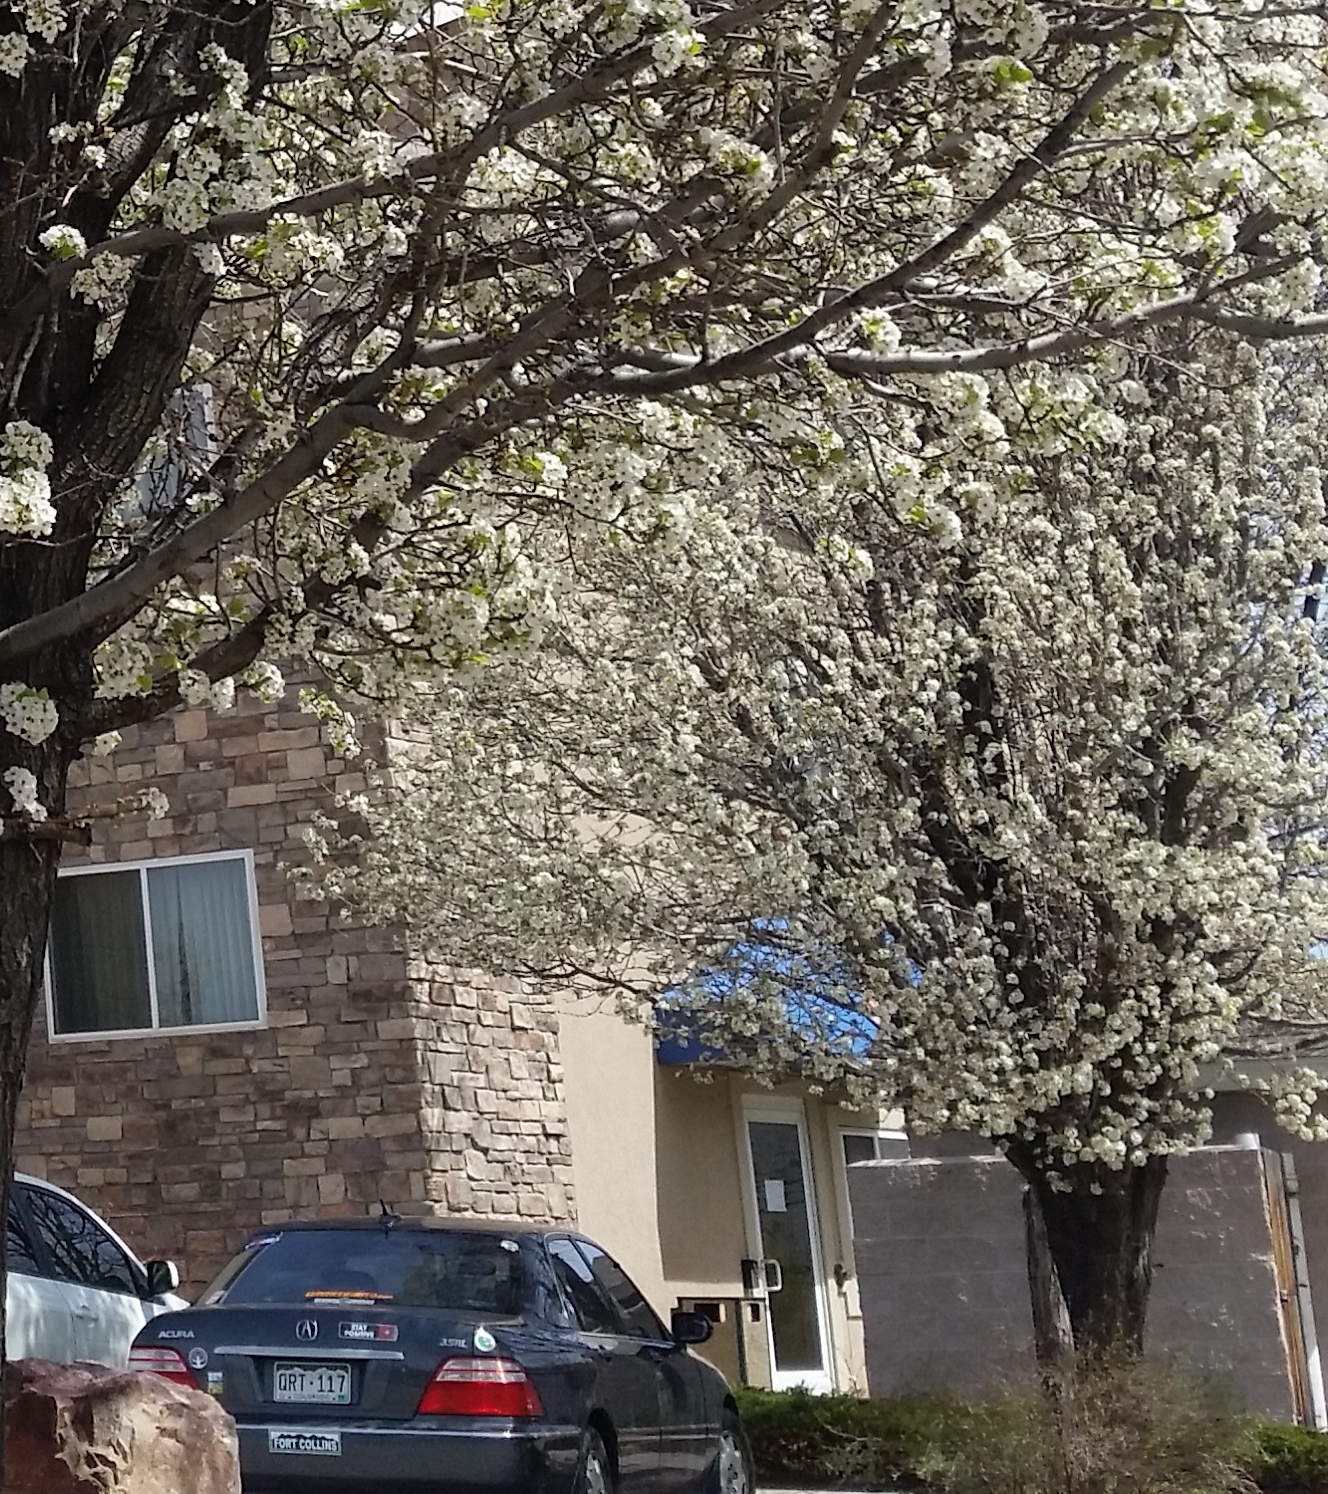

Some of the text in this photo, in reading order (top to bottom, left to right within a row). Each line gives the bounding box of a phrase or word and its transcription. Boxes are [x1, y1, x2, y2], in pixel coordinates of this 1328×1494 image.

[158, 1330, 195, 1339] ACURA
[273, 1437, 338, 1451] FORT COLLINS
